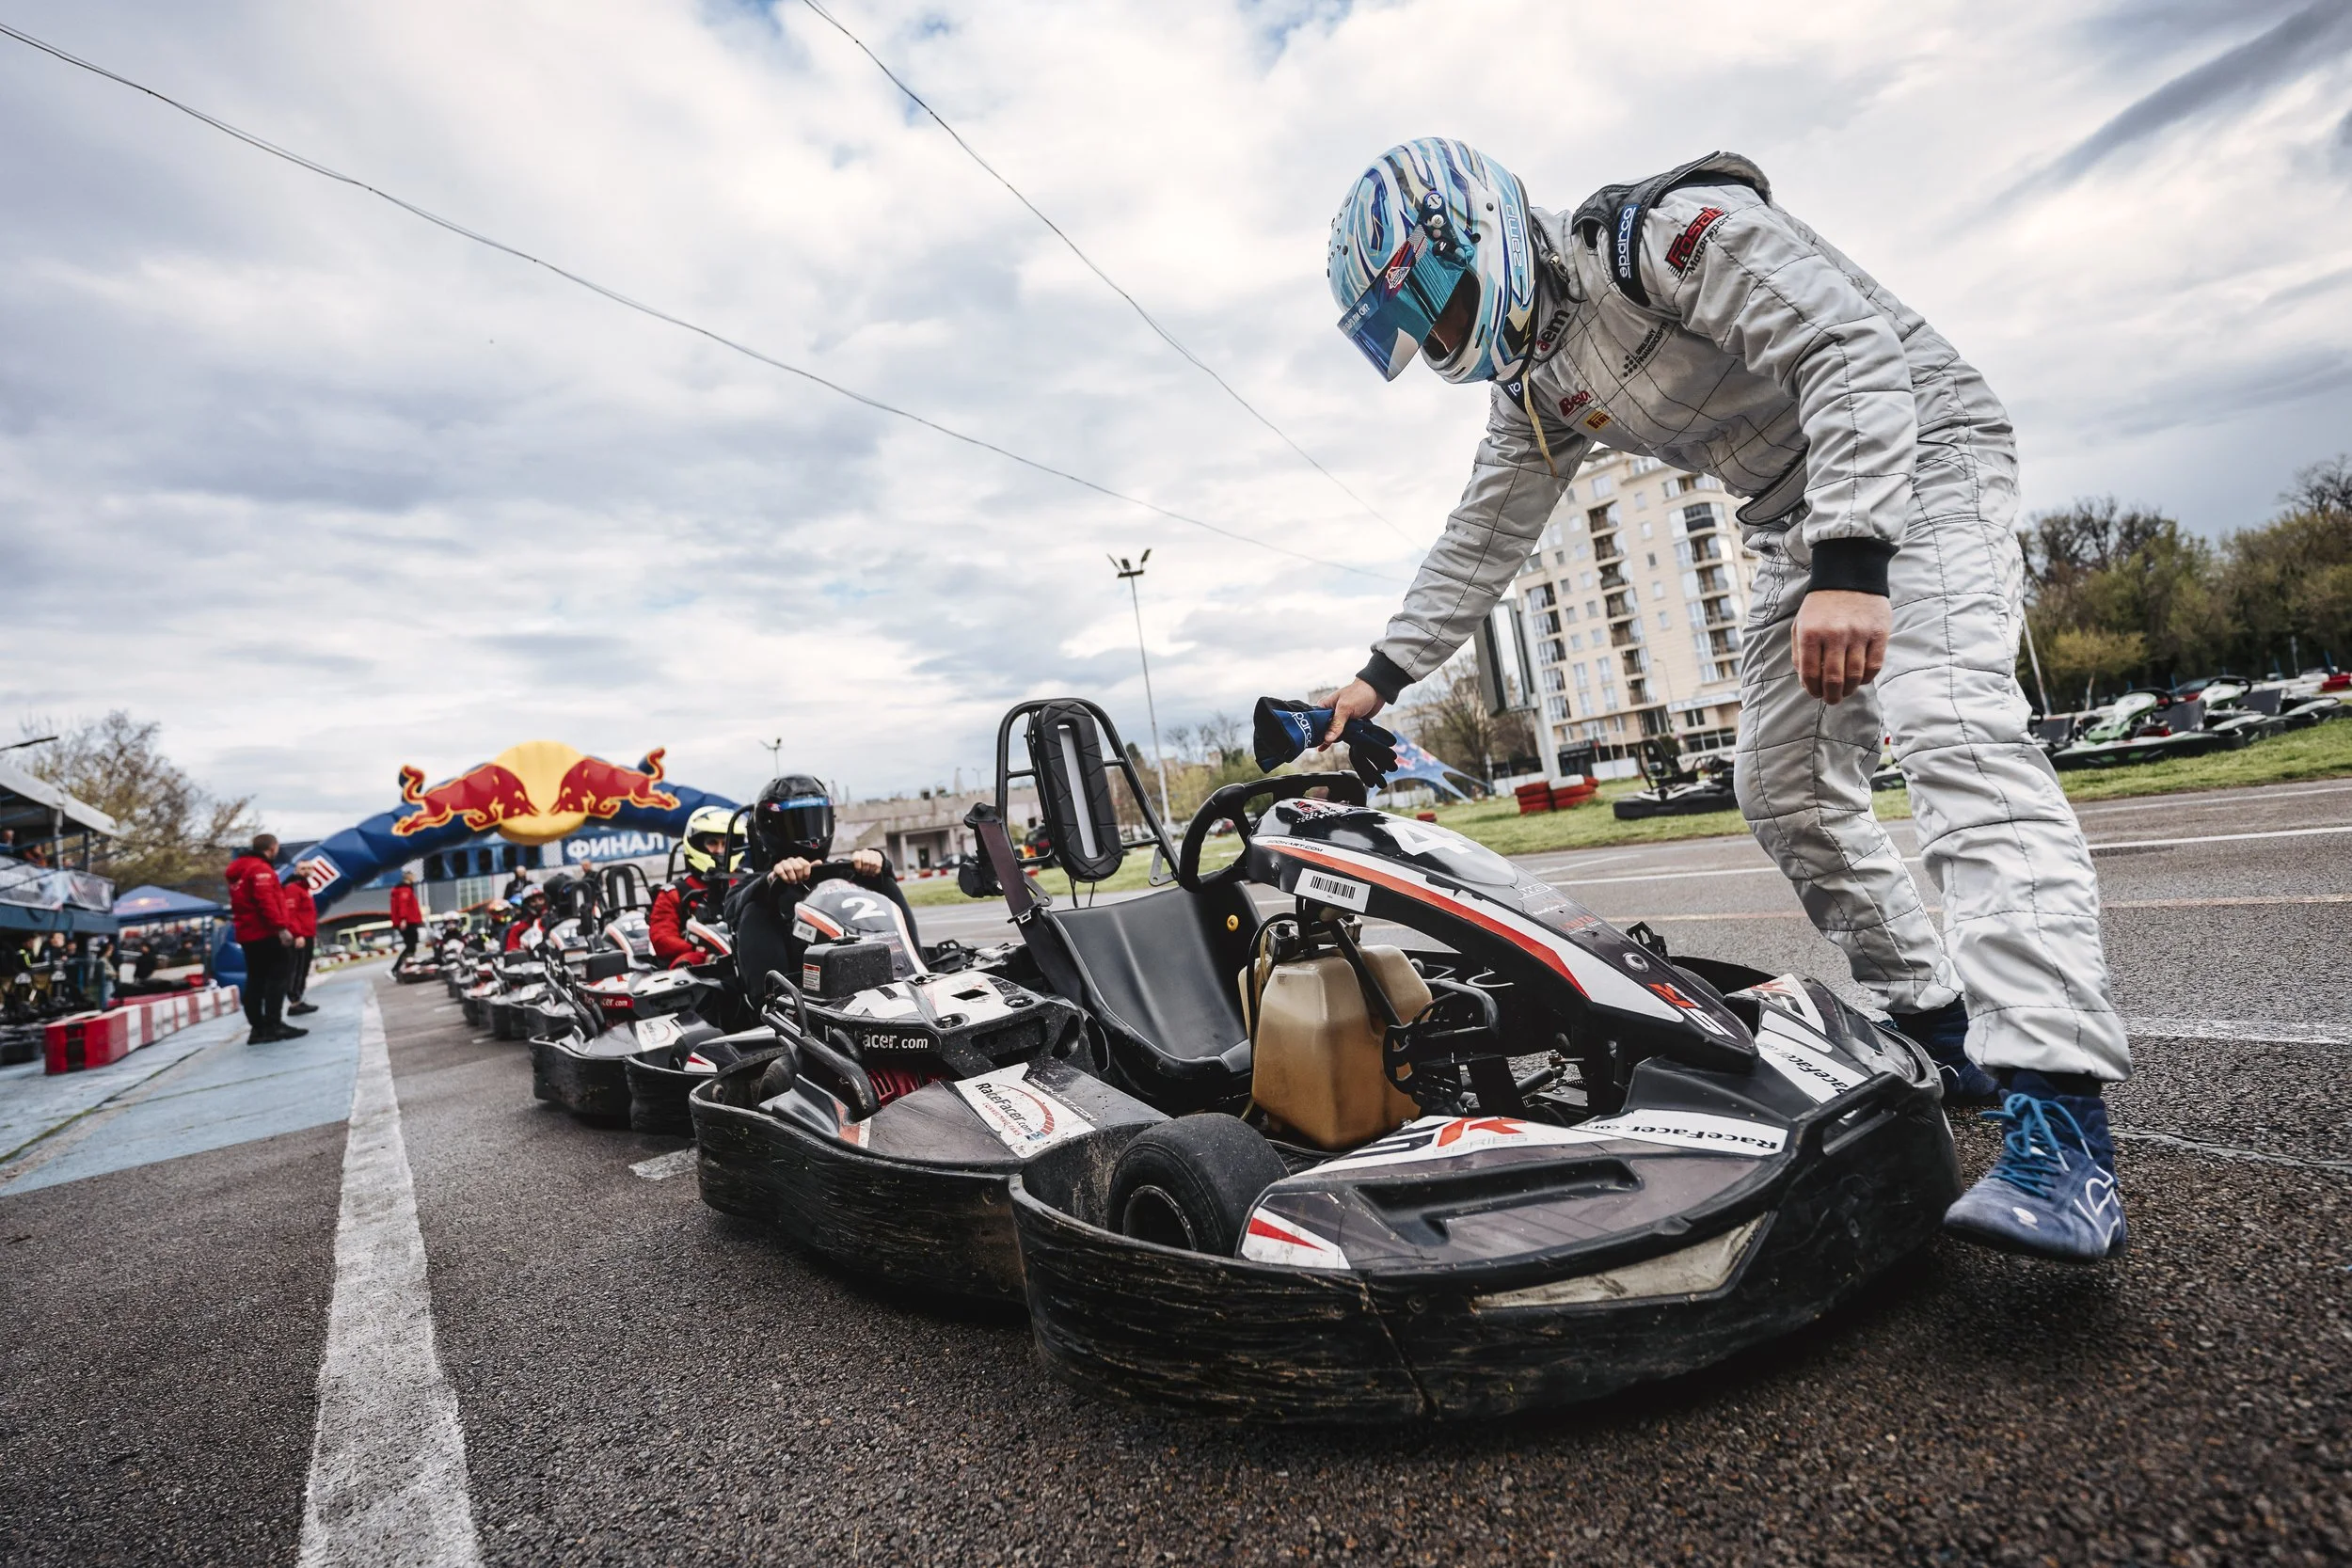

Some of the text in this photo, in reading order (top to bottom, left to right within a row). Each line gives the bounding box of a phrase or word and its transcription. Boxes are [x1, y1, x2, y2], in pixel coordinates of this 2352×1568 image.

[566, 832, 665, 860] ФИНАЛ
[1384, 821, 1475, 857] 4
[308, 860, 336, 891] ull
[841, 896, 887, 921] 2
[975, 1083, 1034, 1133] RaceFacer.com
